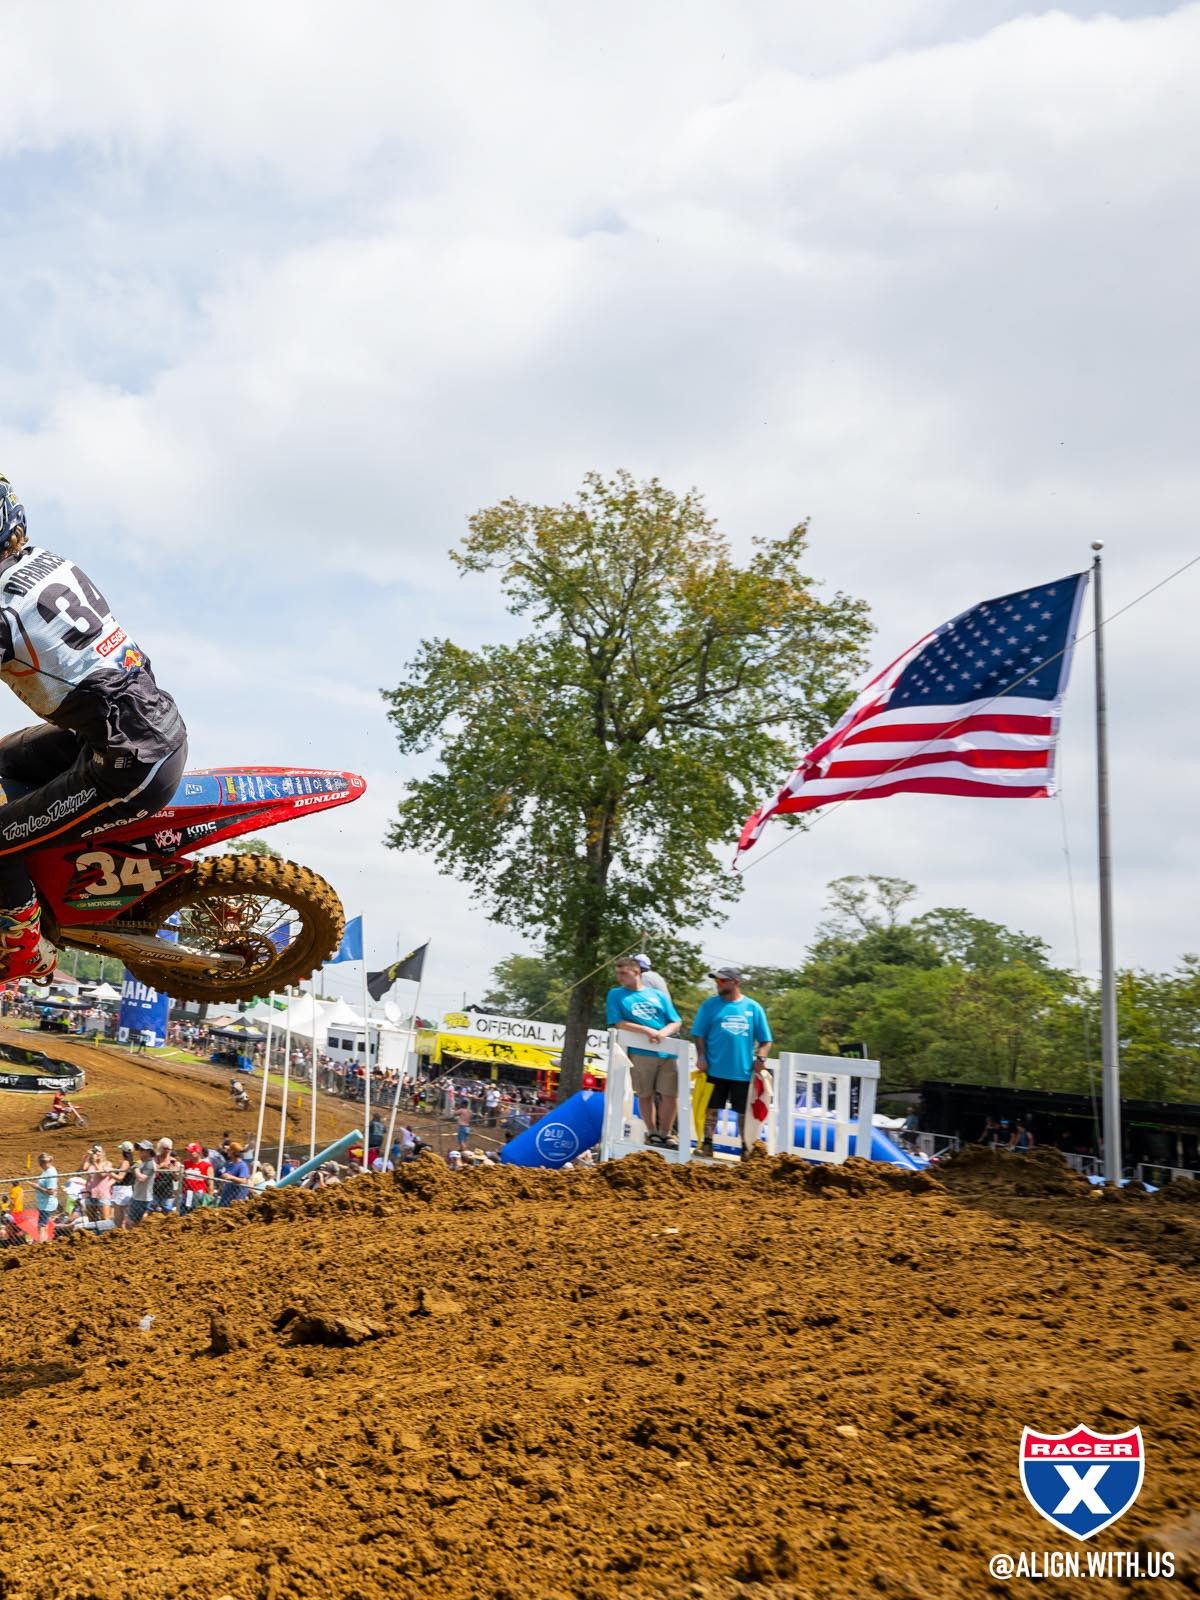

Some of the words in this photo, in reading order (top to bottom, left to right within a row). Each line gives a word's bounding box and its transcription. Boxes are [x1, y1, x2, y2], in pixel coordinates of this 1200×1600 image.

[36, 564, 111, 651] 34
[2, 820, 29, 841] Troy
[28, 814, 51, 832] Lee
[47, 788, 97, 822] Designs
[294, 790, 350, 808] DUNLOP
[75, 851, 163, 896] 34
[475, 1018, 547, 1041] OFFICIAL
[552, 1028, 611, 1050] MCH
